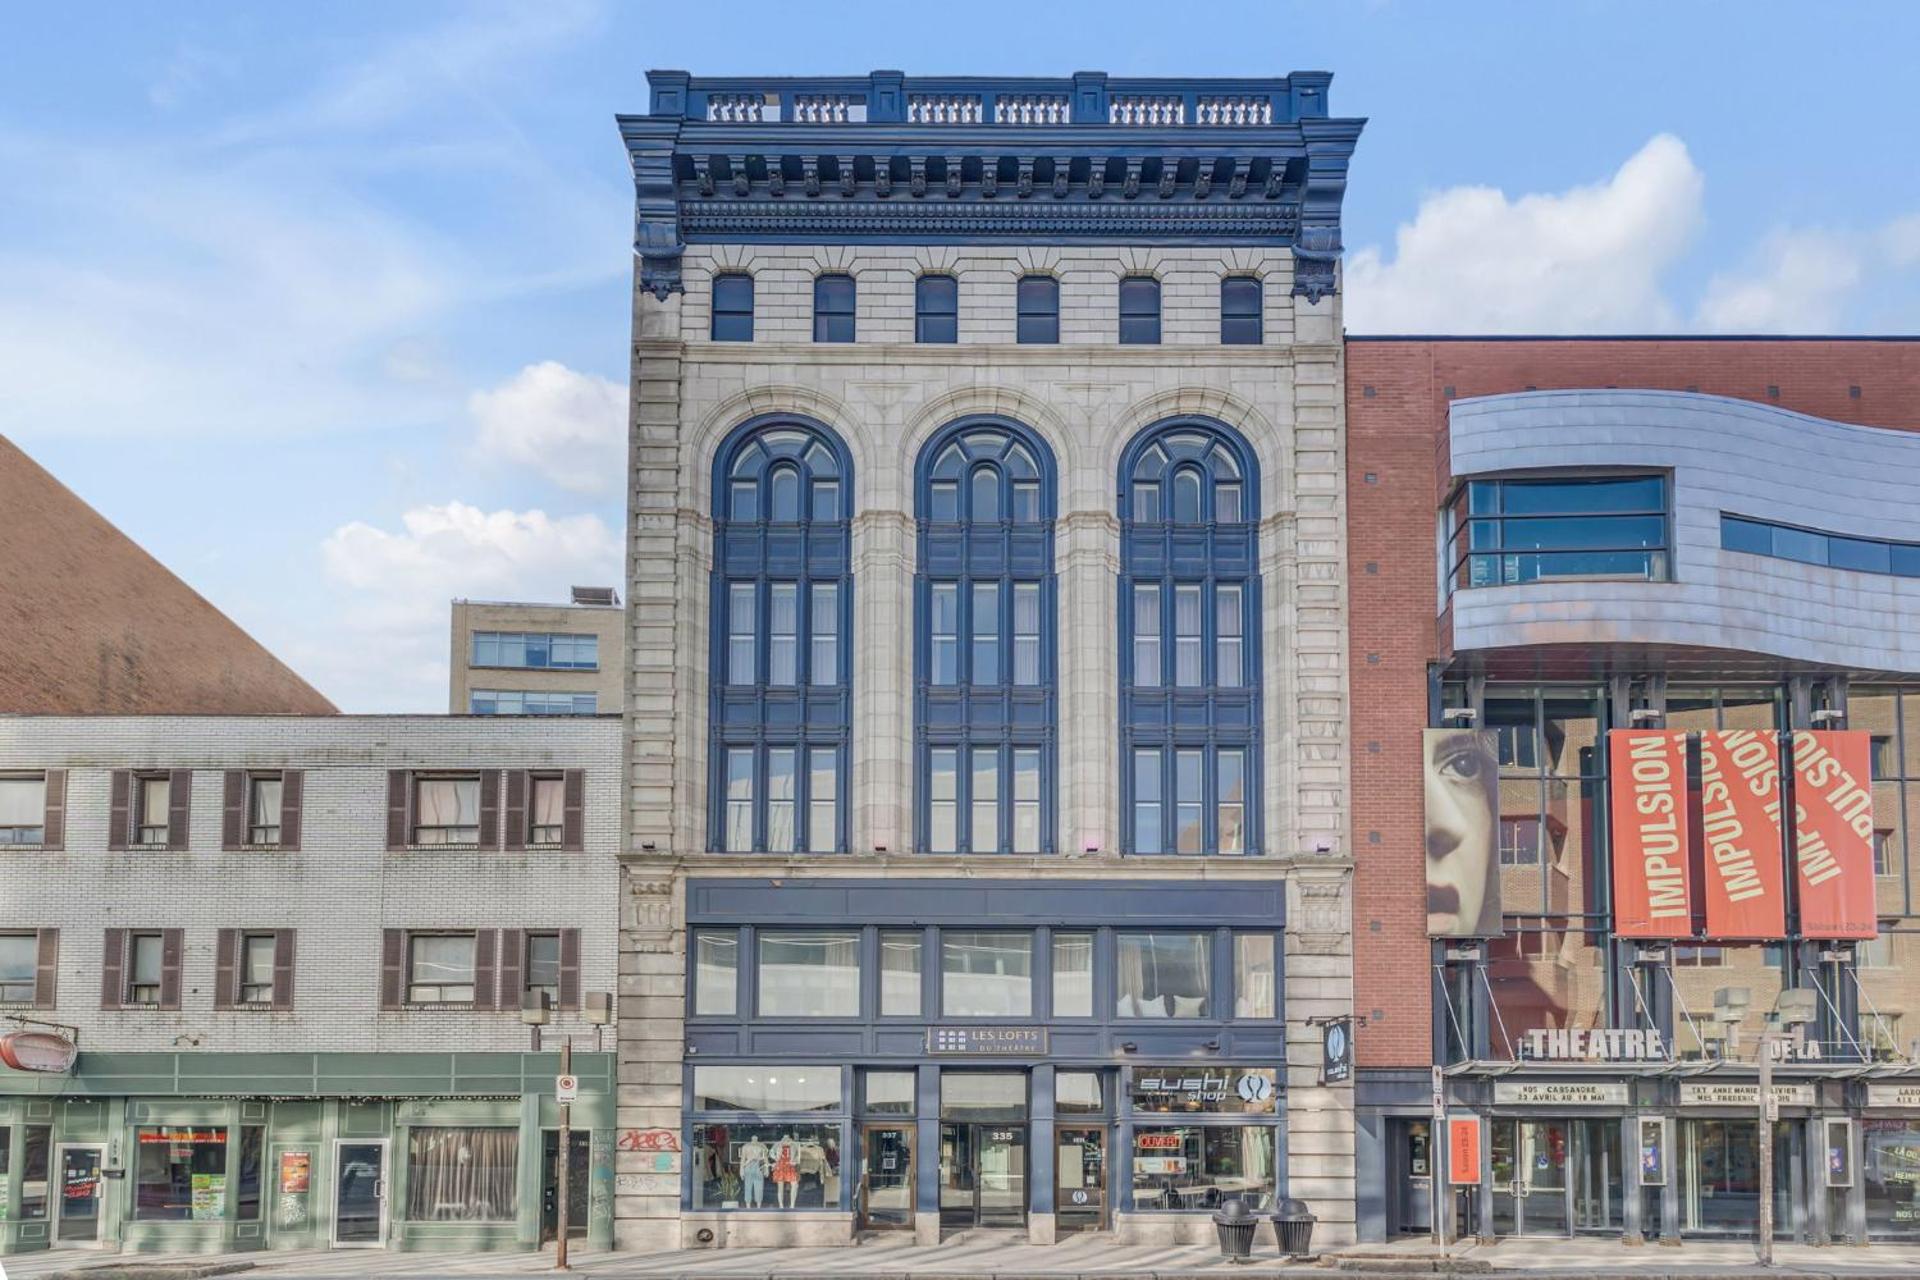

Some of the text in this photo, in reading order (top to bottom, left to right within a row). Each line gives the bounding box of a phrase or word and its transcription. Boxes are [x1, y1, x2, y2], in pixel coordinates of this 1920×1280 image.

[1629, 736, 1687, 918] IMPULSION
[972, 1031, 1039, 1041] LES LOFTS
[1140, 1072, 1230, 1090] sushi
[1187, 1090, 1227, 1102] shop
[1770, 1087, 1797, 1095] LIVIER
[992, 1132, 1013, 1140] 335
